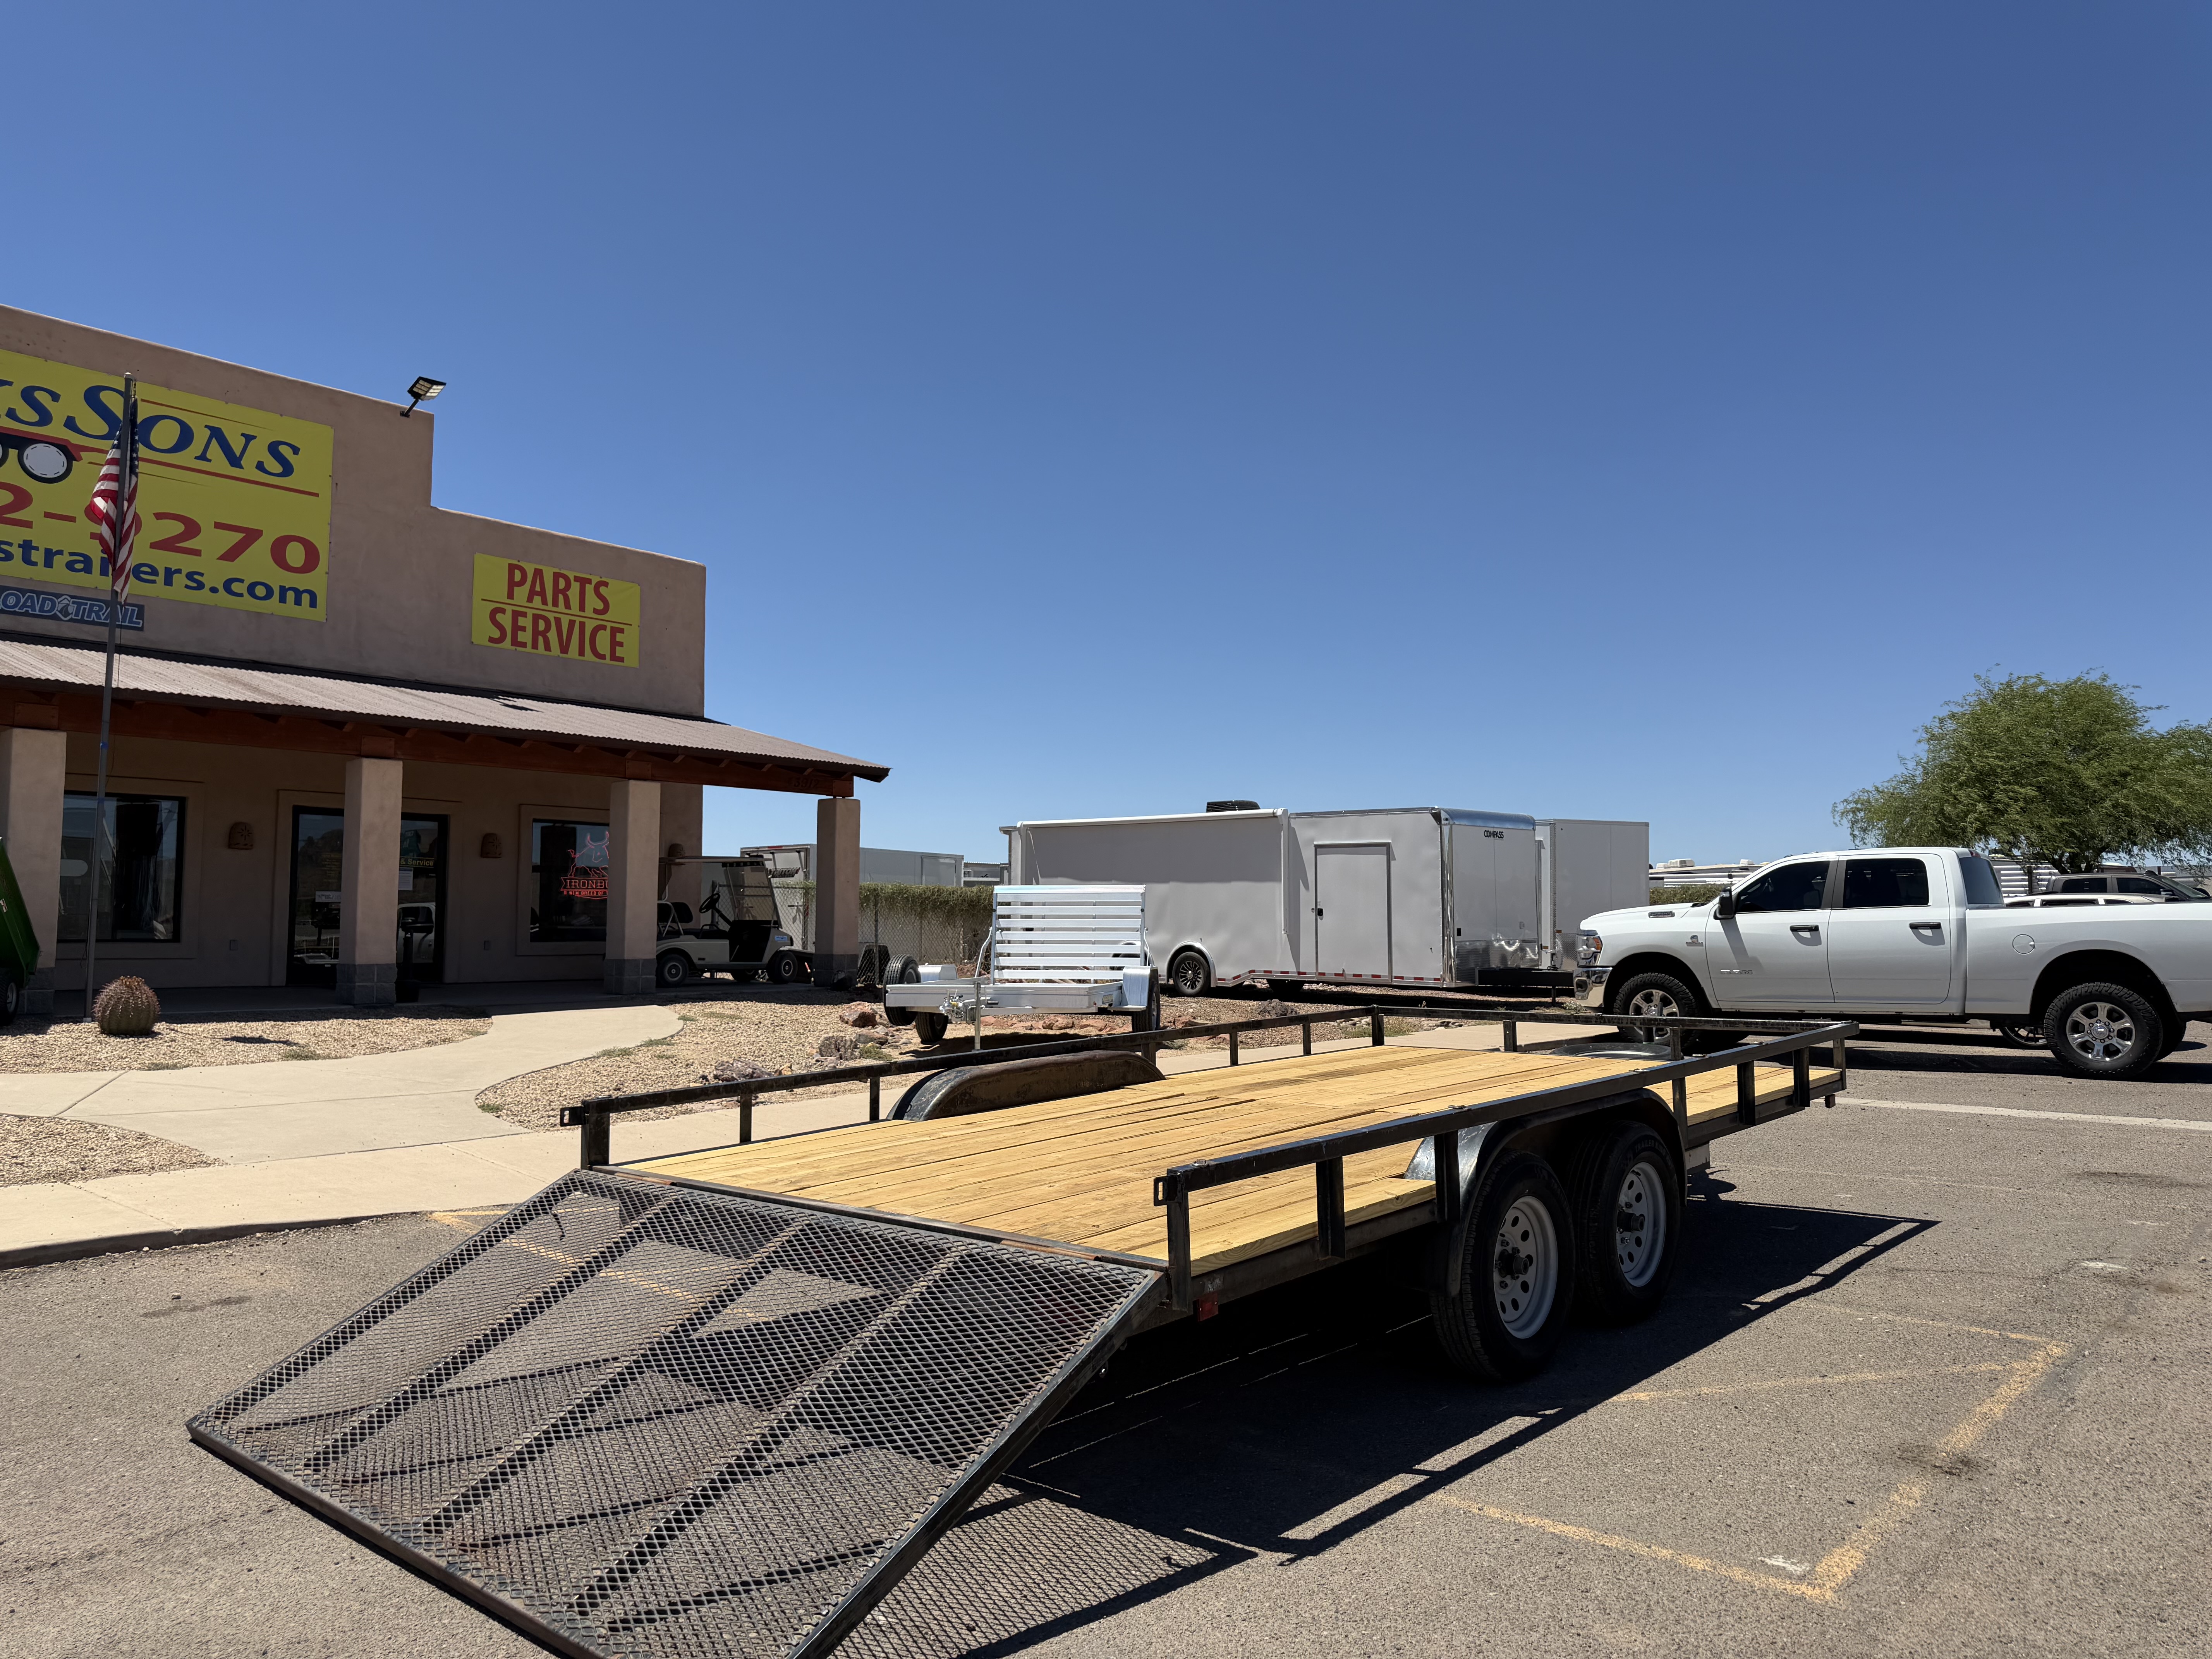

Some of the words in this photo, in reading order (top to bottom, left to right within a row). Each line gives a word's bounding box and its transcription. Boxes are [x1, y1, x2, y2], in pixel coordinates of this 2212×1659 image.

[0, 539, 318, 608] straiers.com
[507, 563, 610, 615] PARTS
[0, 590, 59, 615] OAD
[488, 607, 625, 663] SERVICE
[1484, 830, 1504, 839] COMPASS
